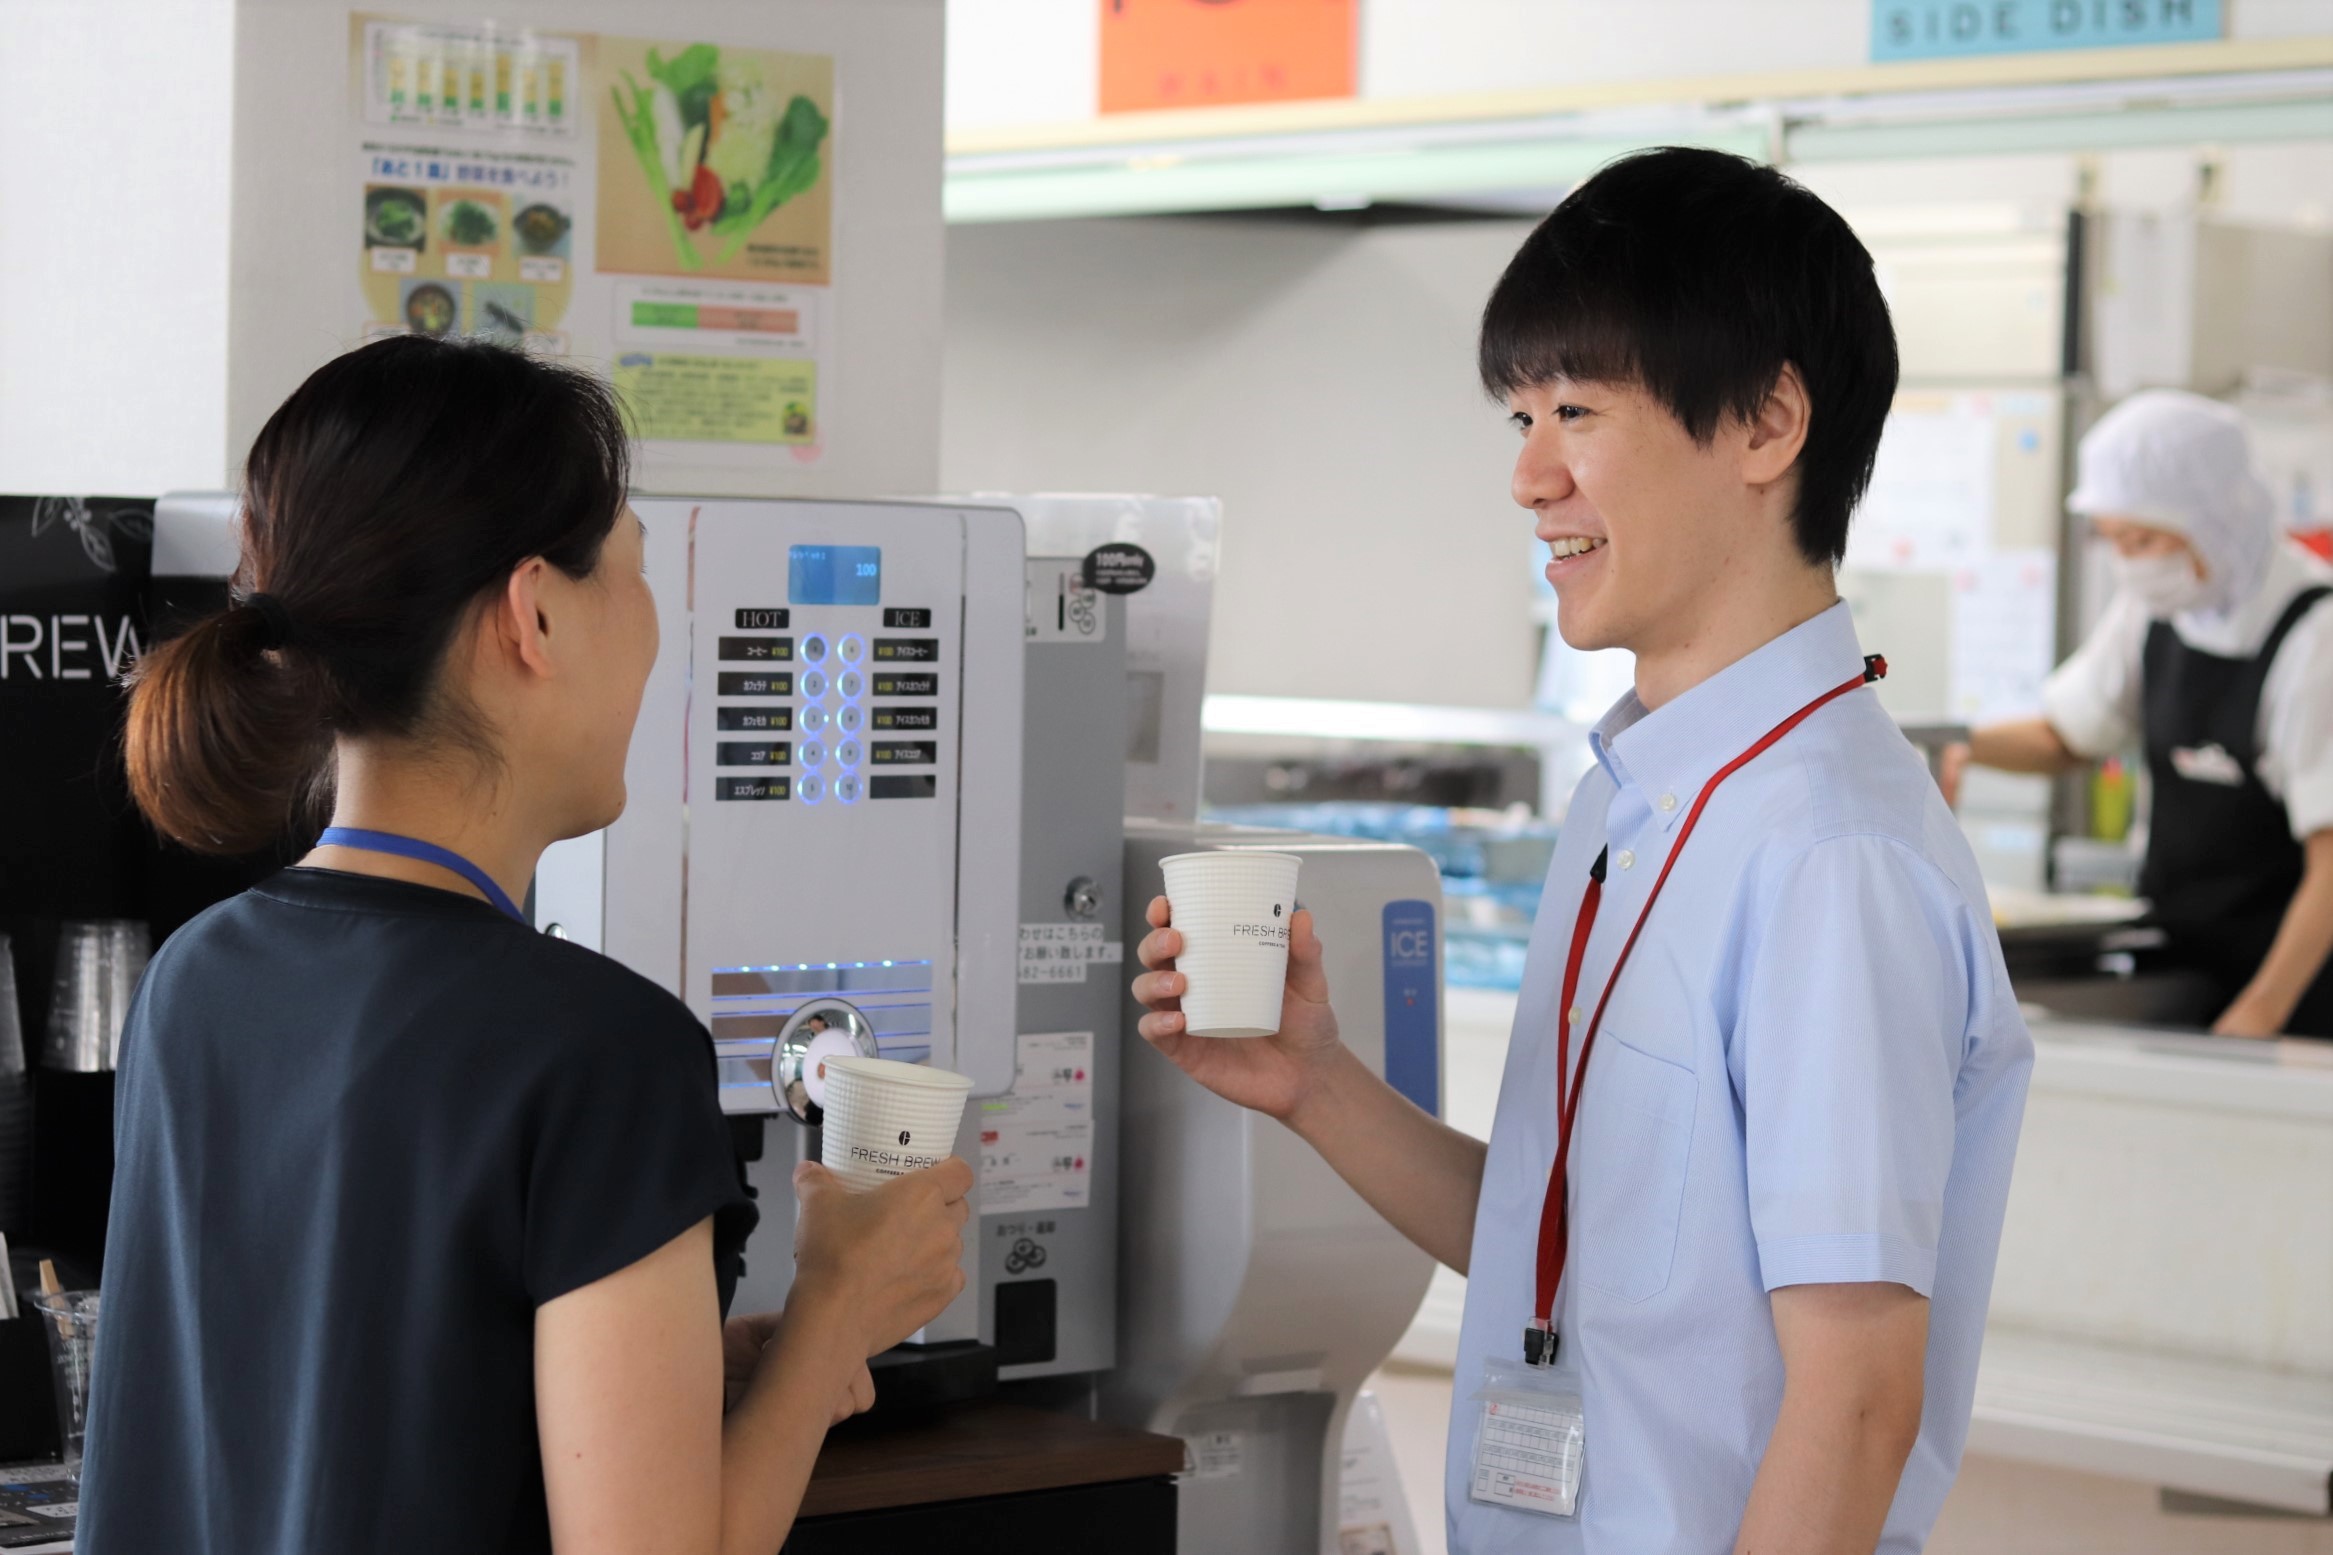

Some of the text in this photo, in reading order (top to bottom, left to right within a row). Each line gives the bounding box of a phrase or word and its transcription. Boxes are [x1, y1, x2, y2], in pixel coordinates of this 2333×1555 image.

[1886, 0, 2193, 46] SIDE DISH
[856, 563, 877, 577] 100
[743, 611, 781, 627] HOT
[895, 611, 921, 627] ICE
[0, 614, 141, 680] REW
[772, 647, 788, 657] ¥100
[771, 681, 788, 692] ¥100
[771, 716, 787, 726] ¥100
[770, 751, 786, 761] ¥100
[769, 786, 785, 796] ¥100
[1233, 924, 1276, 938] FRESH
[1391, 929, 1428, 958] ICE
[1019, 946, 1113, 960] お願い致します。
[851, 1147, 900, 1166] FRESH
